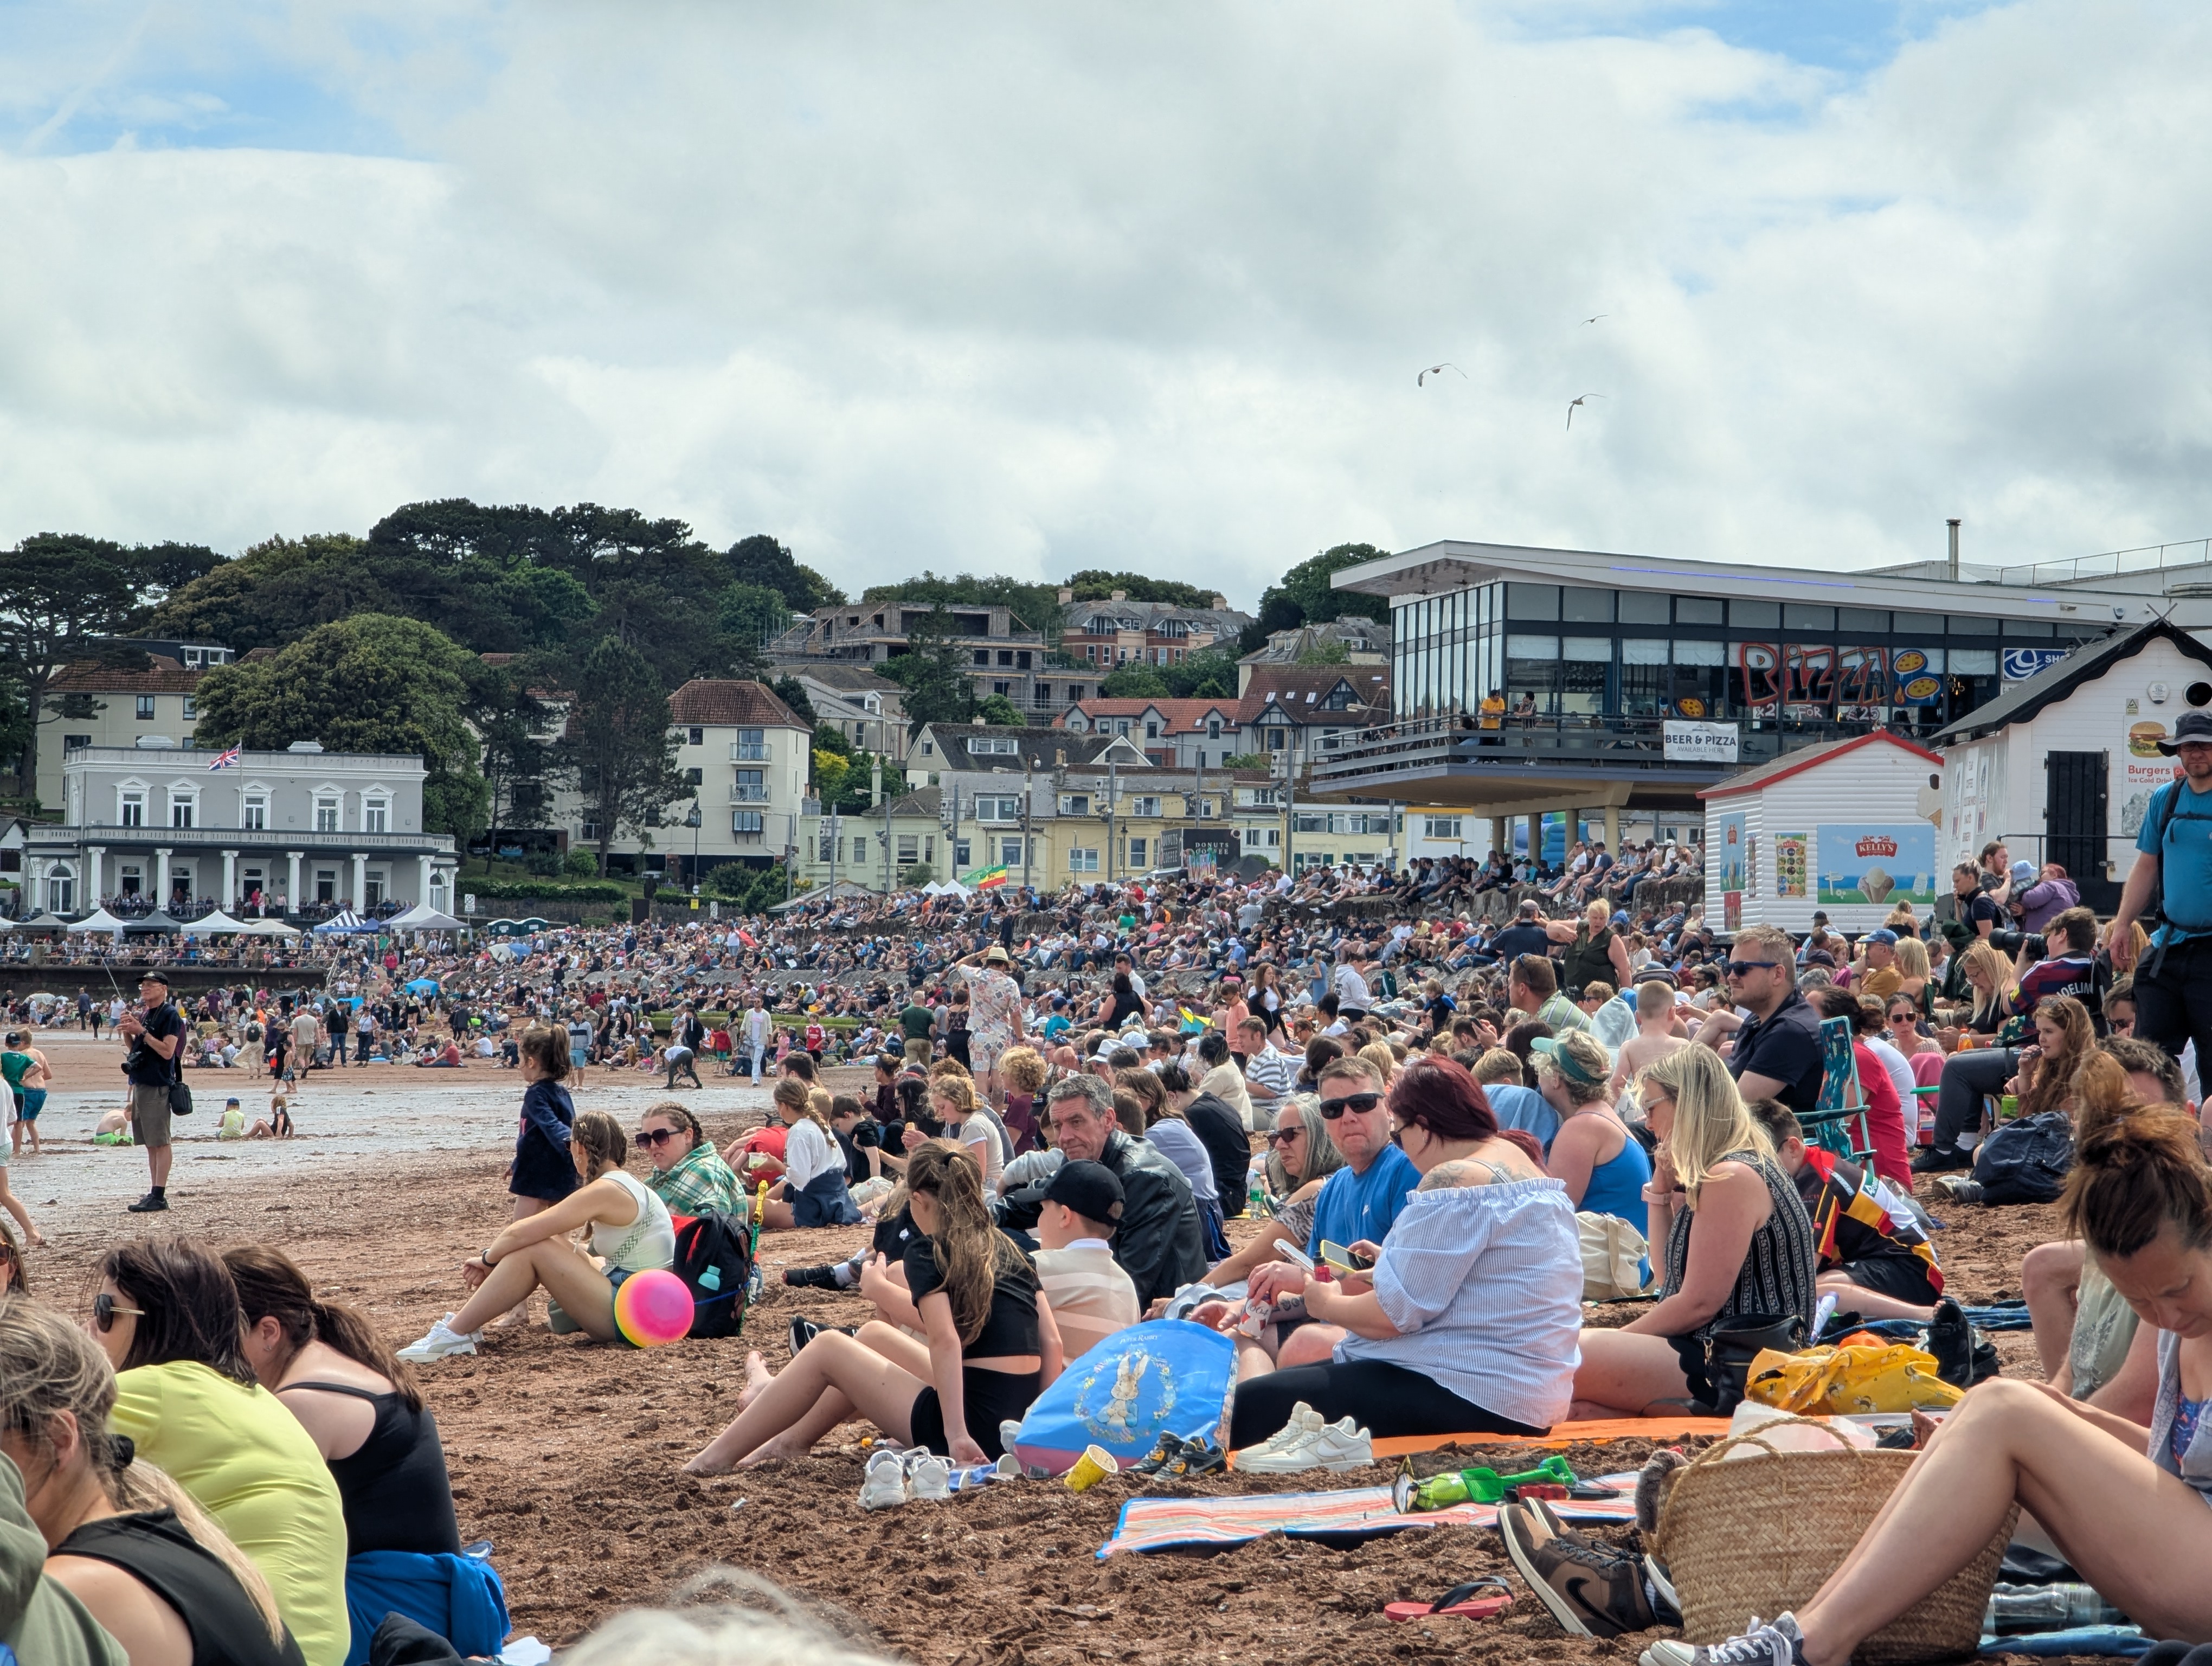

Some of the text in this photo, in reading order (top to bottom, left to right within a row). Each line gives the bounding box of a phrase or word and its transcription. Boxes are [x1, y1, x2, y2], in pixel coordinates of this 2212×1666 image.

[1797, 707, 1822, 721] FOR
[1846, 706, 1880, 721] £25
[1666, 734, 1737, 746] BEER & PIZZA
[2128, 765, 2170, 777] Burgers
[1859, 843, 1894, 852] KELLY'S
[1163, 850, 1178, 863] COFFEE
